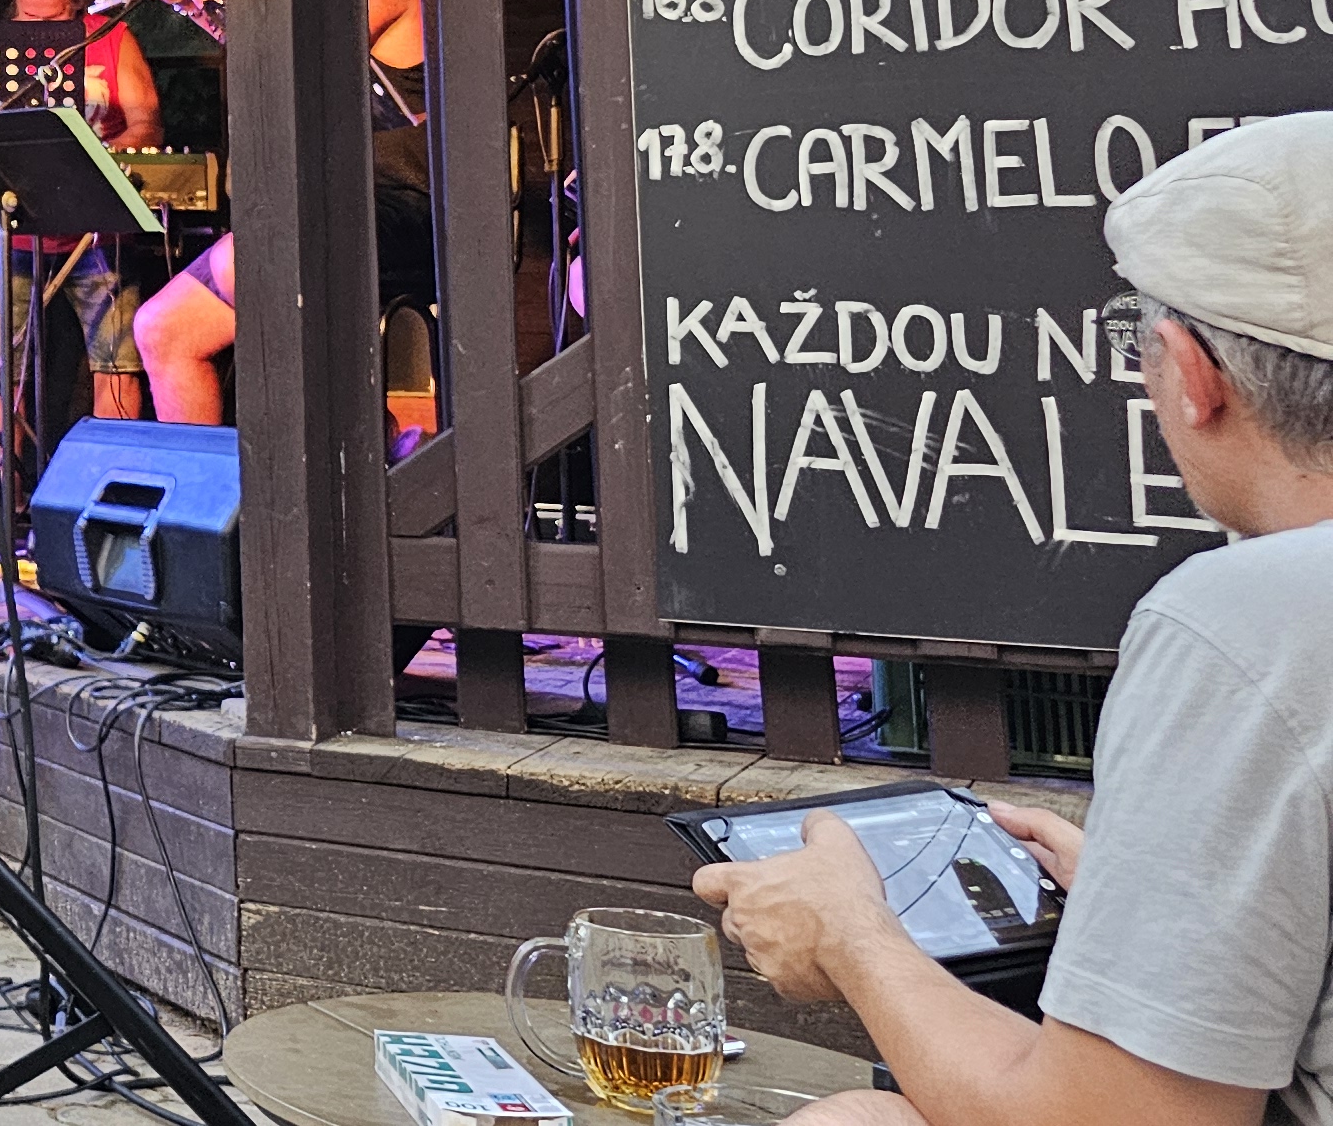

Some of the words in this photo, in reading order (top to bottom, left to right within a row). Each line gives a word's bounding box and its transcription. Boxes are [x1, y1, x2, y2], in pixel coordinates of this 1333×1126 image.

[744, 115, 1155, 212] CARMELO
[667, 289, 1001, 374] KAŽDOU
[378, 1033, 474, 1094] GIZEH
